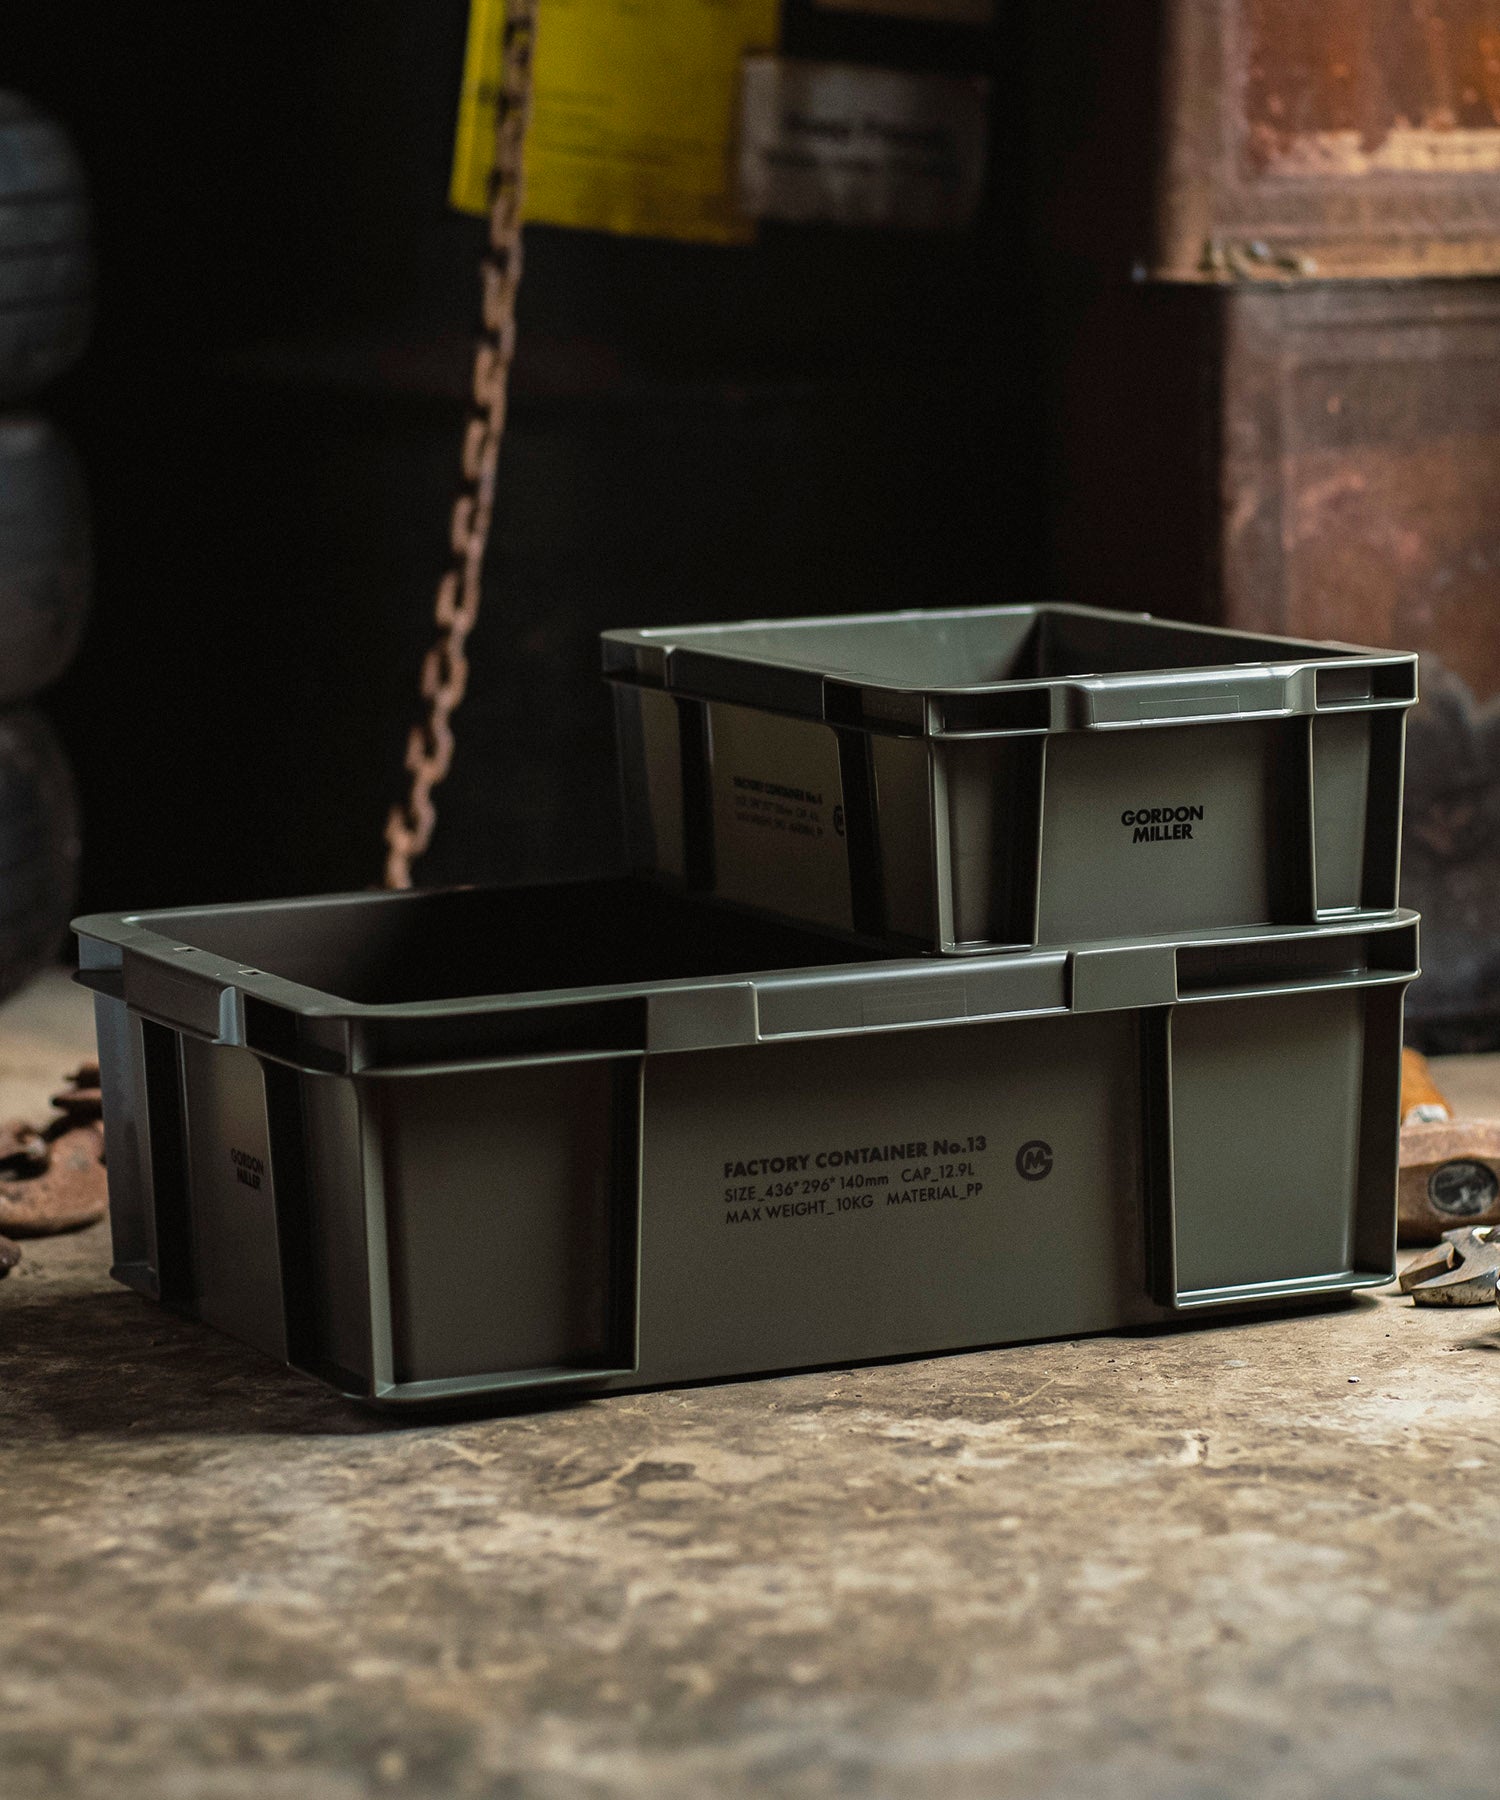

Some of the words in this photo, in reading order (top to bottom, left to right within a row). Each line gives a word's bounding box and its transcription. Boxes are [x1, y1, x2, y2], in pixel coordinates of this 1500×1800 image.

[1121, 805, 1203, 826] GORDON
[1132, 823, 1193, 843] MILLER
[724, 1154, 809, 1178] FACTORY
[815, 1141, 928, 1169] CONTAINER
[933, 1135, 987, 1157] No.13
[726, 1208, 762, 1225] MAX
[767, 1194, 874, 1220] WEIGHT_10KG
[886, 1183, 983, 1207] MATERIAL_PP
